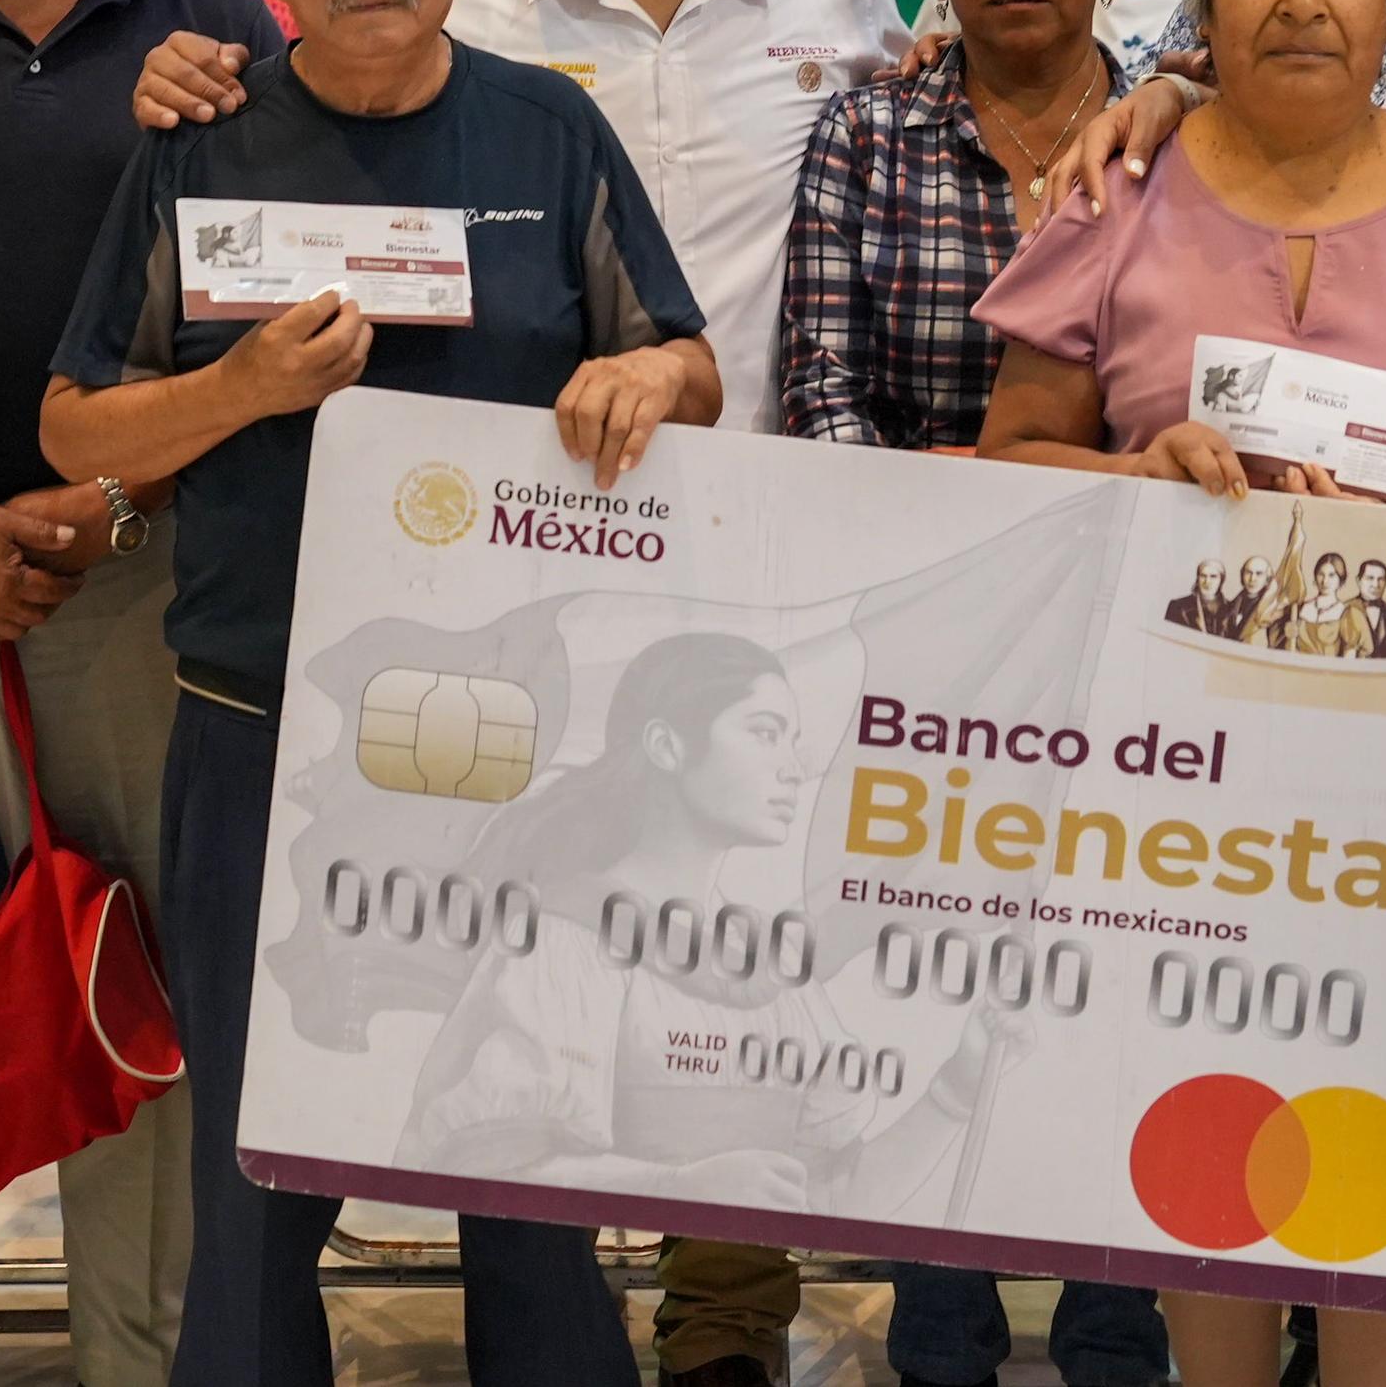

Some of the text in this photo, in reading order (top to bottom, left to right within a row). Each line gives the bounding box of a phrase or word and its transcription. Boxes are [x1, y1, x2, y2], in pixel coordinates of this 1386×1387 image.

[483, 208, 545, 222] BOEING
[385, 243, 441, 254] Bienestar
[494, 479, 670, 520] Gobierno de
[488, 505, 665, 562] México
[857, 695, 1226, 784] Banco del
[840, 879, 1249, 943] El banco de los mexicanos
[322, 857, 1368, 1048] 0000 0000 0000 0000
[664, 1053, 721, 1075] THRU
[666, 1030, 906, 1099] VALID 00/00
